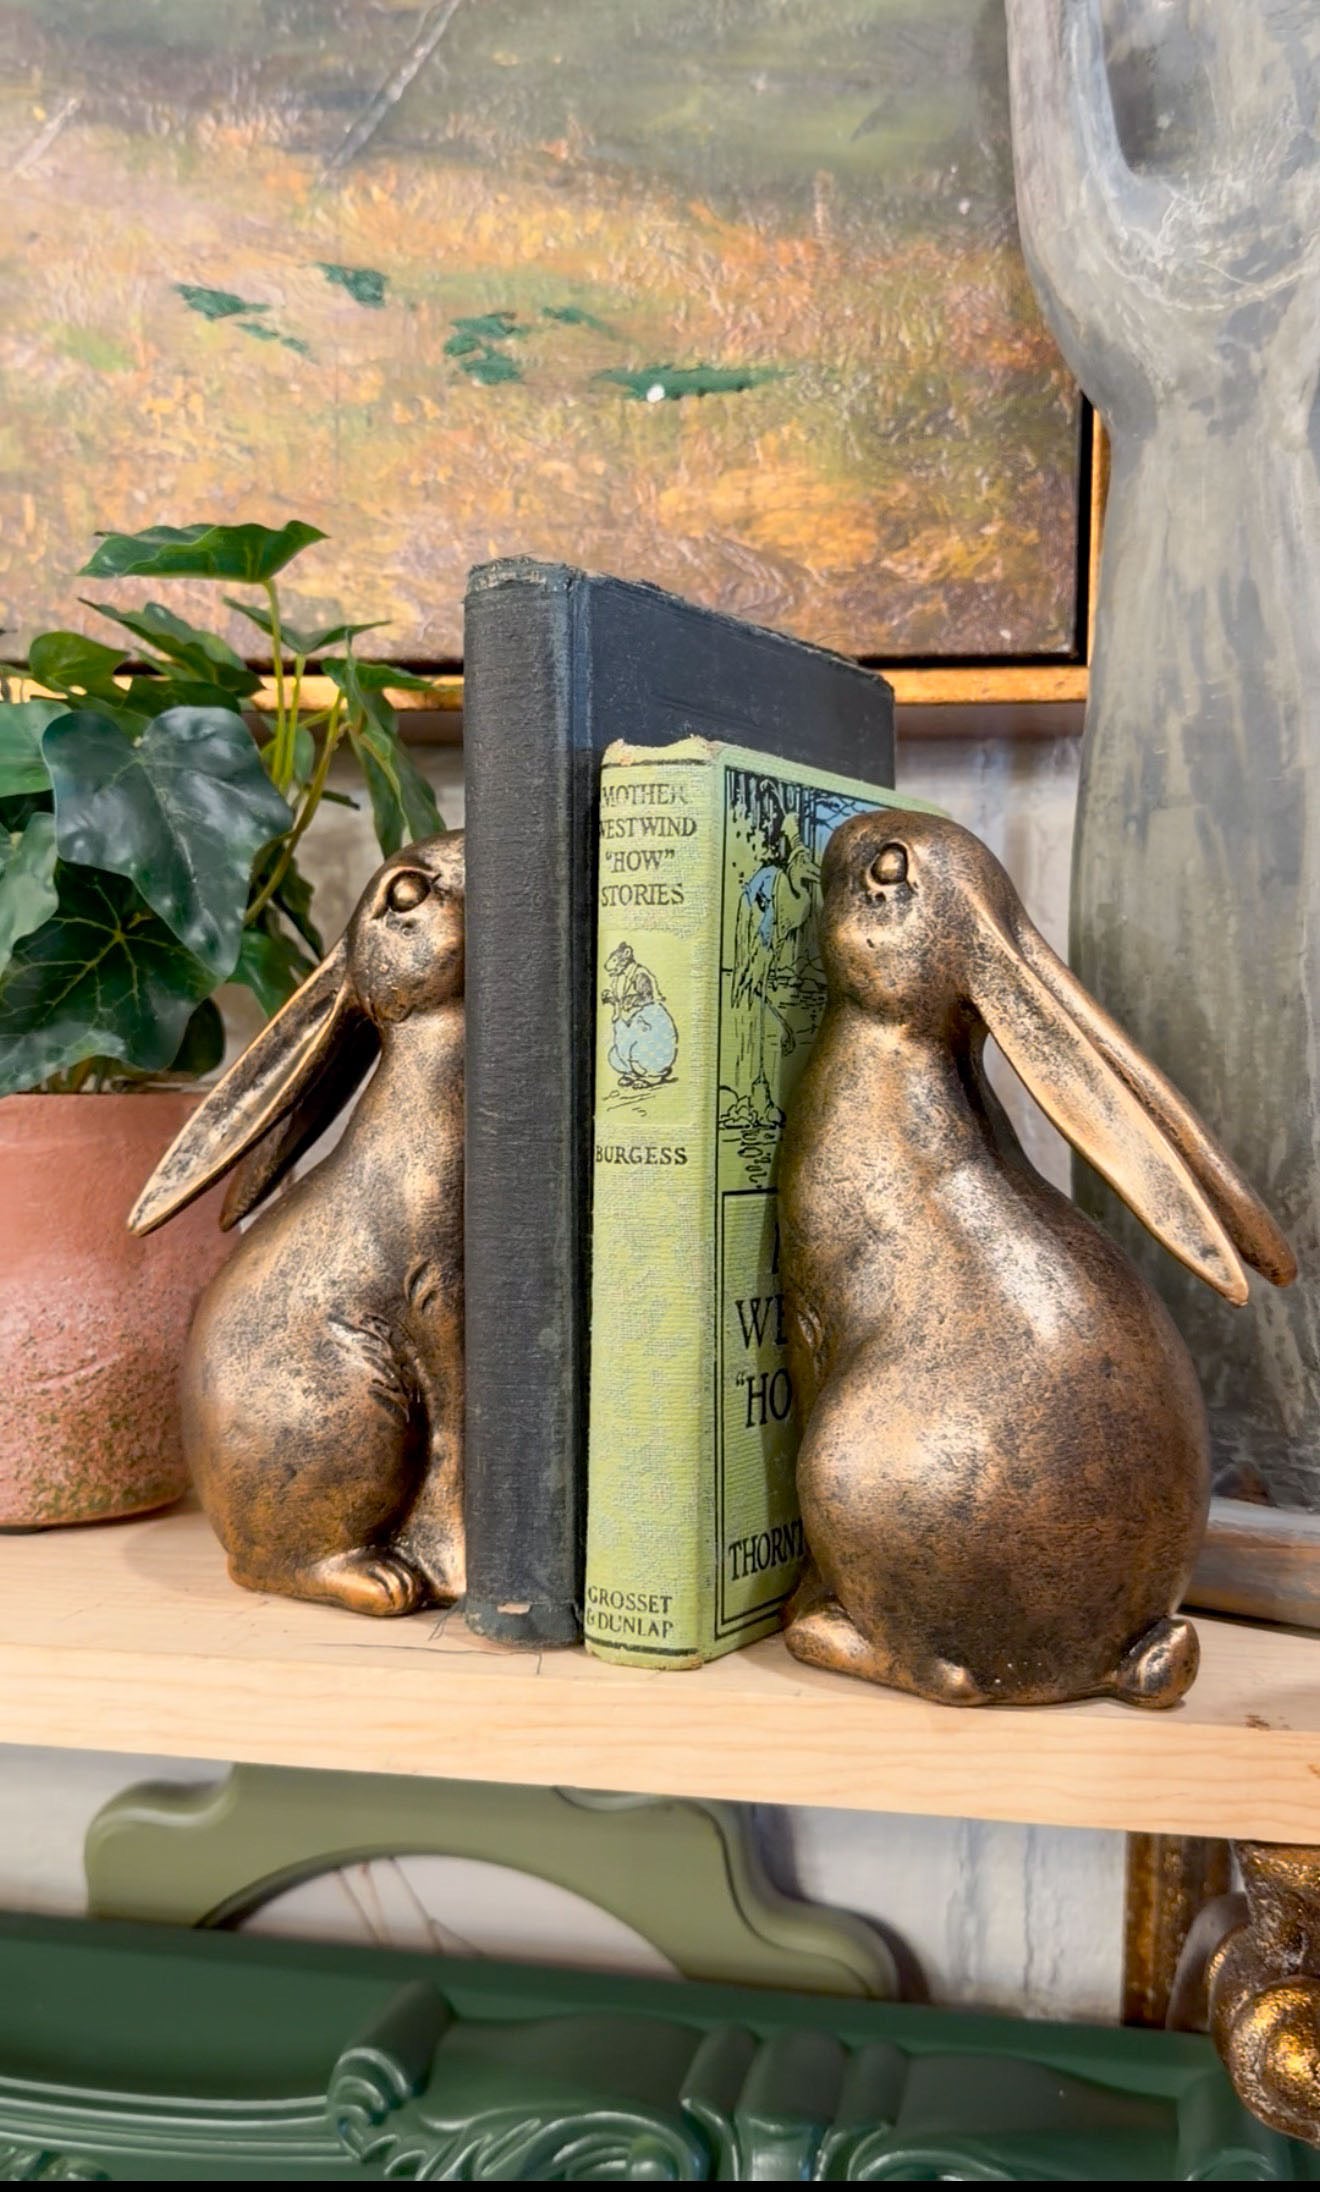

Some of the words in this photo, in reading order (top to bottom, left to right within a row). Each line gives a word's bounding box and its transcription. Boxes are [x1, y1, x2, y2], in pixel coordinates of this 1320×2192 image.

[602, 783, 688, 807] MOTHER
[605, 848, 675, 873] "HOW"
[601, 883, 684, 907] STORIES
[595, 1145, 688, 1165] BURGESS
[588, 1585, 672, 1614] GROSSET
[598, 1612, 674, 1638] DUNLAP
